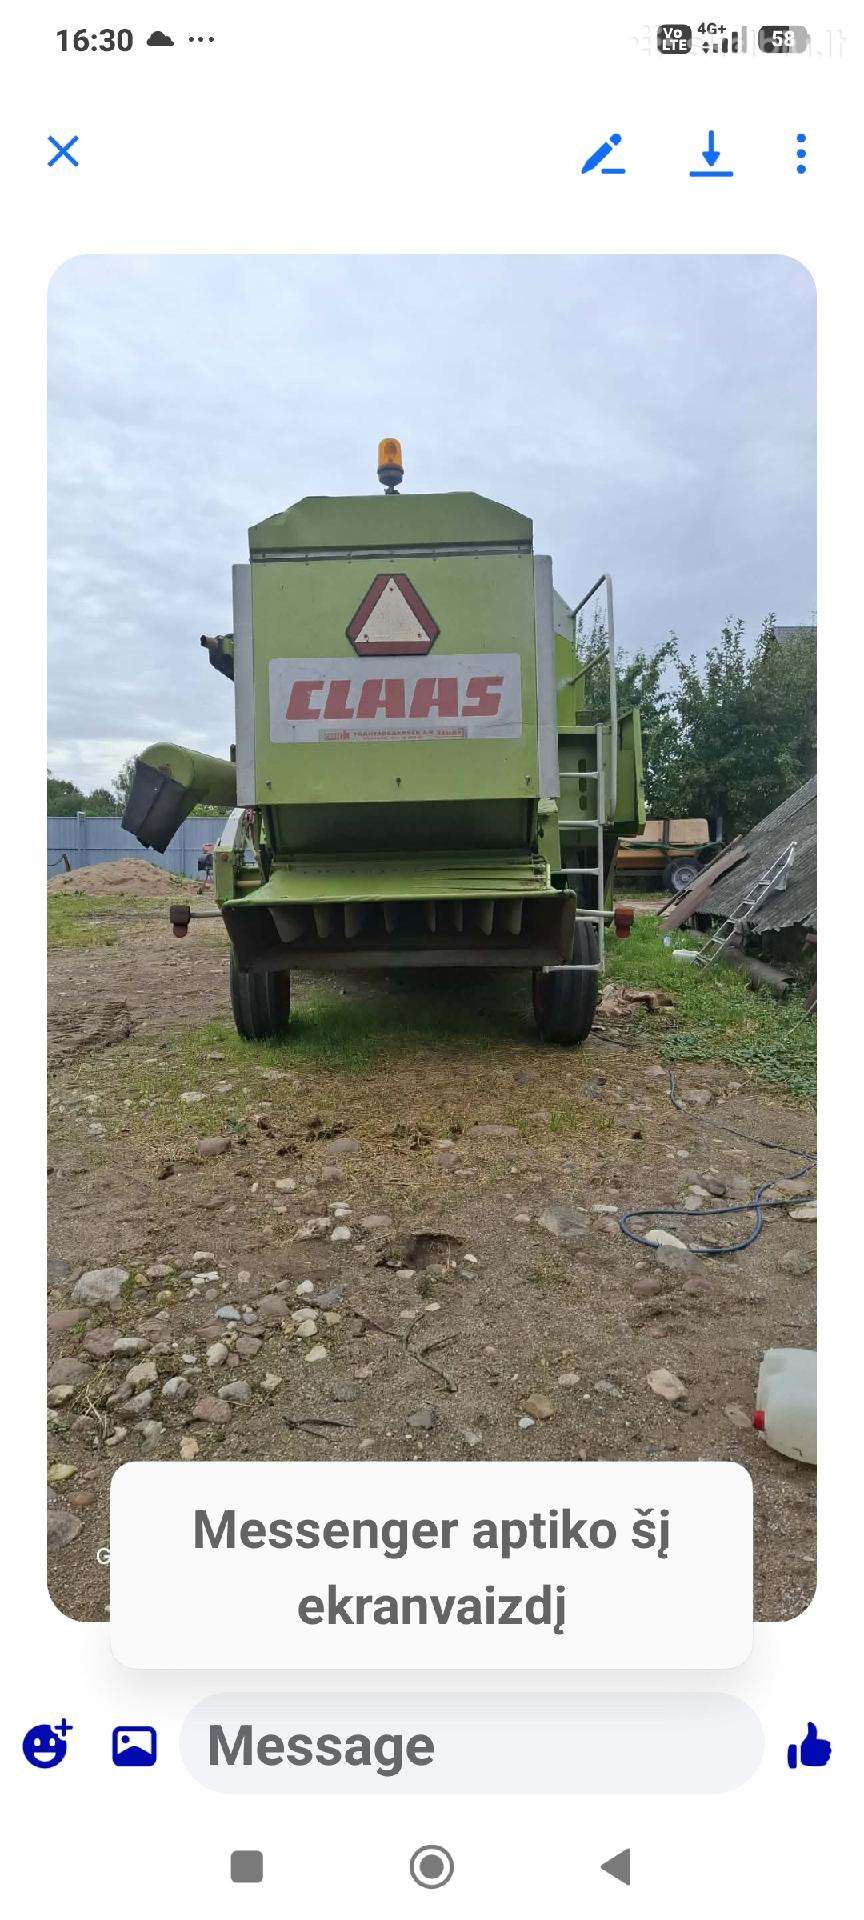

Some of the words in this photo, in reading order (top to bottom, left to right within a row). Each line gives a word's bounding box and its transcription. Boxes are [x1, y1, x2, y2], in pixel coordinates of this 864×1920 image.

[56, 28, 134, 52] 16:30
[662, 27, 683, 39] Vo
[697, 22, 727, 35] 4G+
[771, 30, 796, 47] 58
[662, 39, 688, 51] LTE
[285, 675, 505, 721] CLAAS
[194, 1509, 459, 1560] Messenger
[472, 1508, 617, 1559] aptiko
[631, 1508, 670, 1560] šį
[297, 1584, 566, 1636] ekranvaizdį
[209, 1724, 435, 1778] Message
